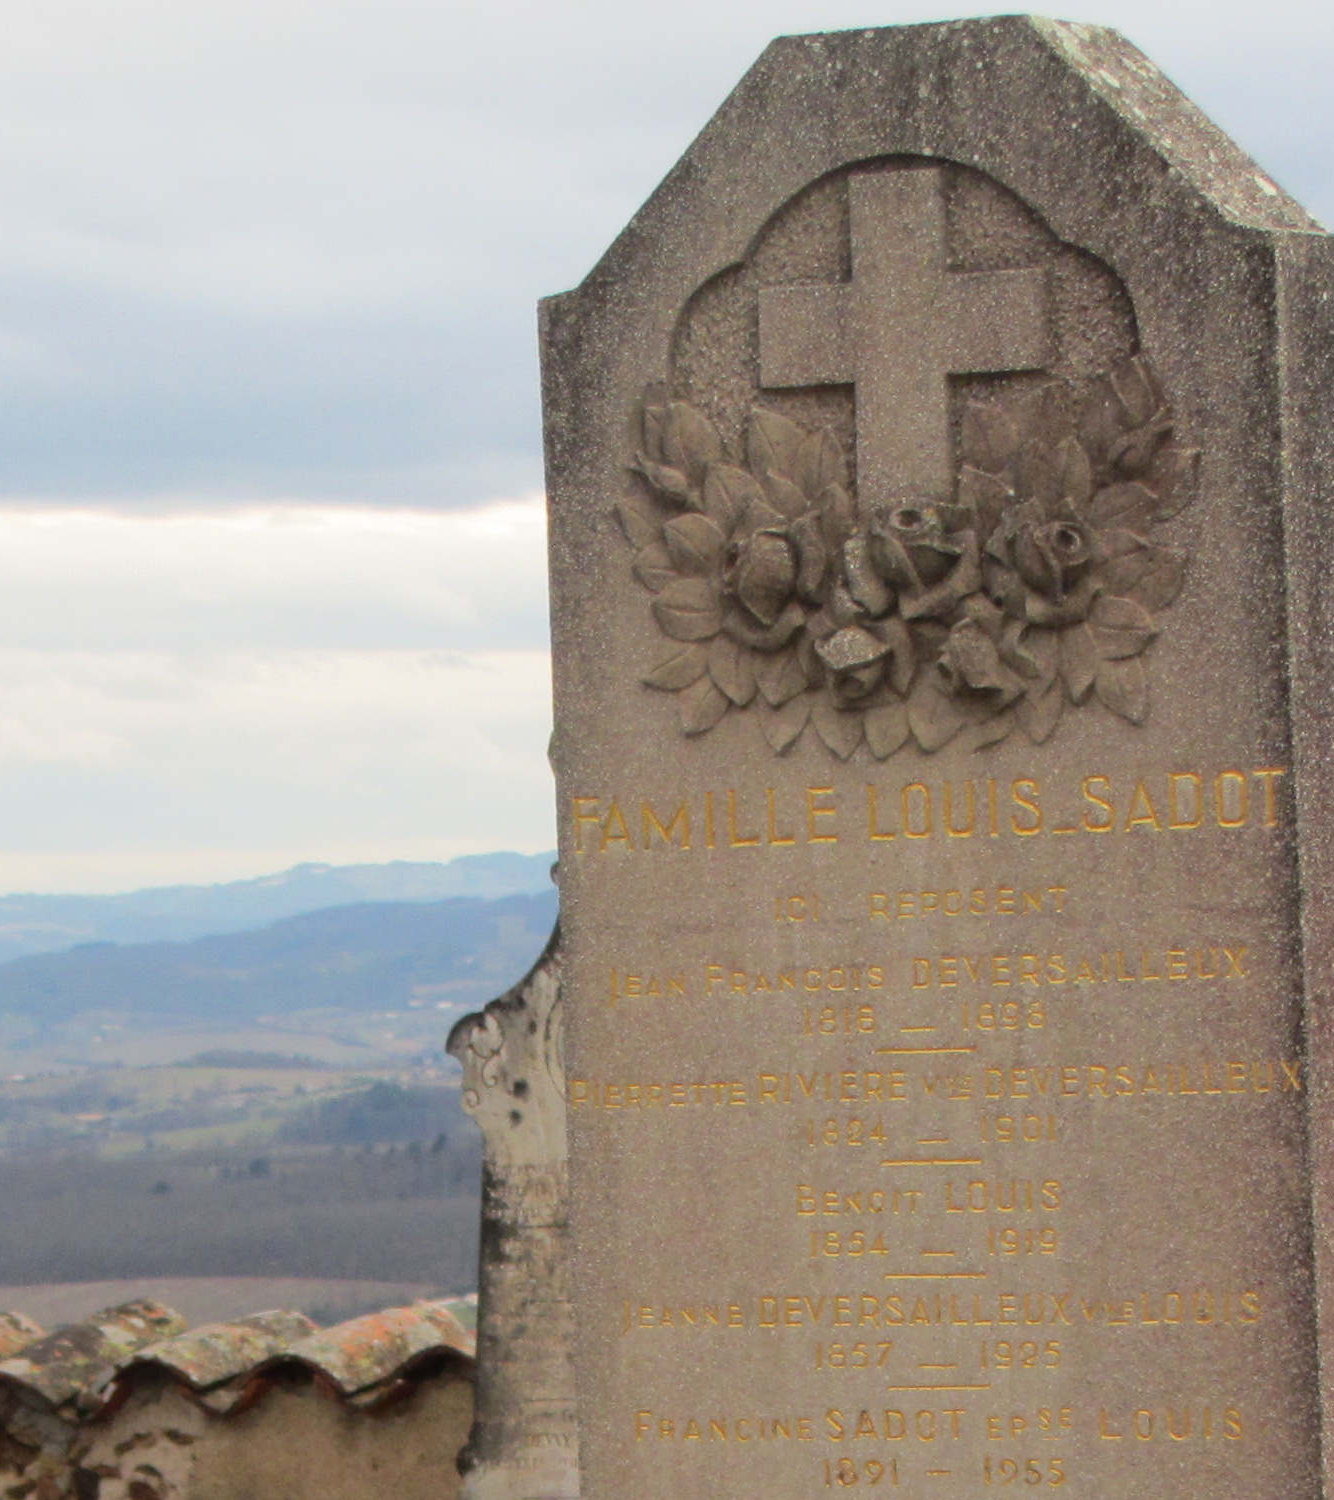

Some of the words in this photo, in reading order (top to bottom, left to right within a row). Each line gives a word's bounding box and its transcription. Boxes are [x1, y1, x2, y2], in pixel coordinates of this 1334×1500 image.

[572, 787, 838, 854] FAMILLE
[774, 896, 820, 922] ICI
[869, 886, 1067, 922] REPOSENT
[912, 946, 1249, 990] DEVERSAILLEUX
[570, 1078, 747, 1111] PIERRETTE
[758, 1070, 907, 1104] RIVIERE
[984, 1059, 1304, 1099] DEVERSAILLEUX
[807, 1115, 889, 1147] 1824
[981, 1114, 1058, 1143] 1901
[796, 1183, 922, 1217] BENOIT
[945, 1180, 1063, 1214] LOUIS
[987, 1228, 1058, 1256] 1919
[759, 1294, 1071, 1328] DEVERSAILLEUX
[1140, 1291, 1262, 1325] LOUIS
[980, 1341, 1062, 1369] 1925
[635, 1411, 816, 1442] FRANCINE
[825, 1408, 966, 1442] SADOT
[1100, 1407, 1244, 1441] LOUIS
[824, 1457, 899, 1488] 1891
[983, 1457, 1065, 1487] 1955
